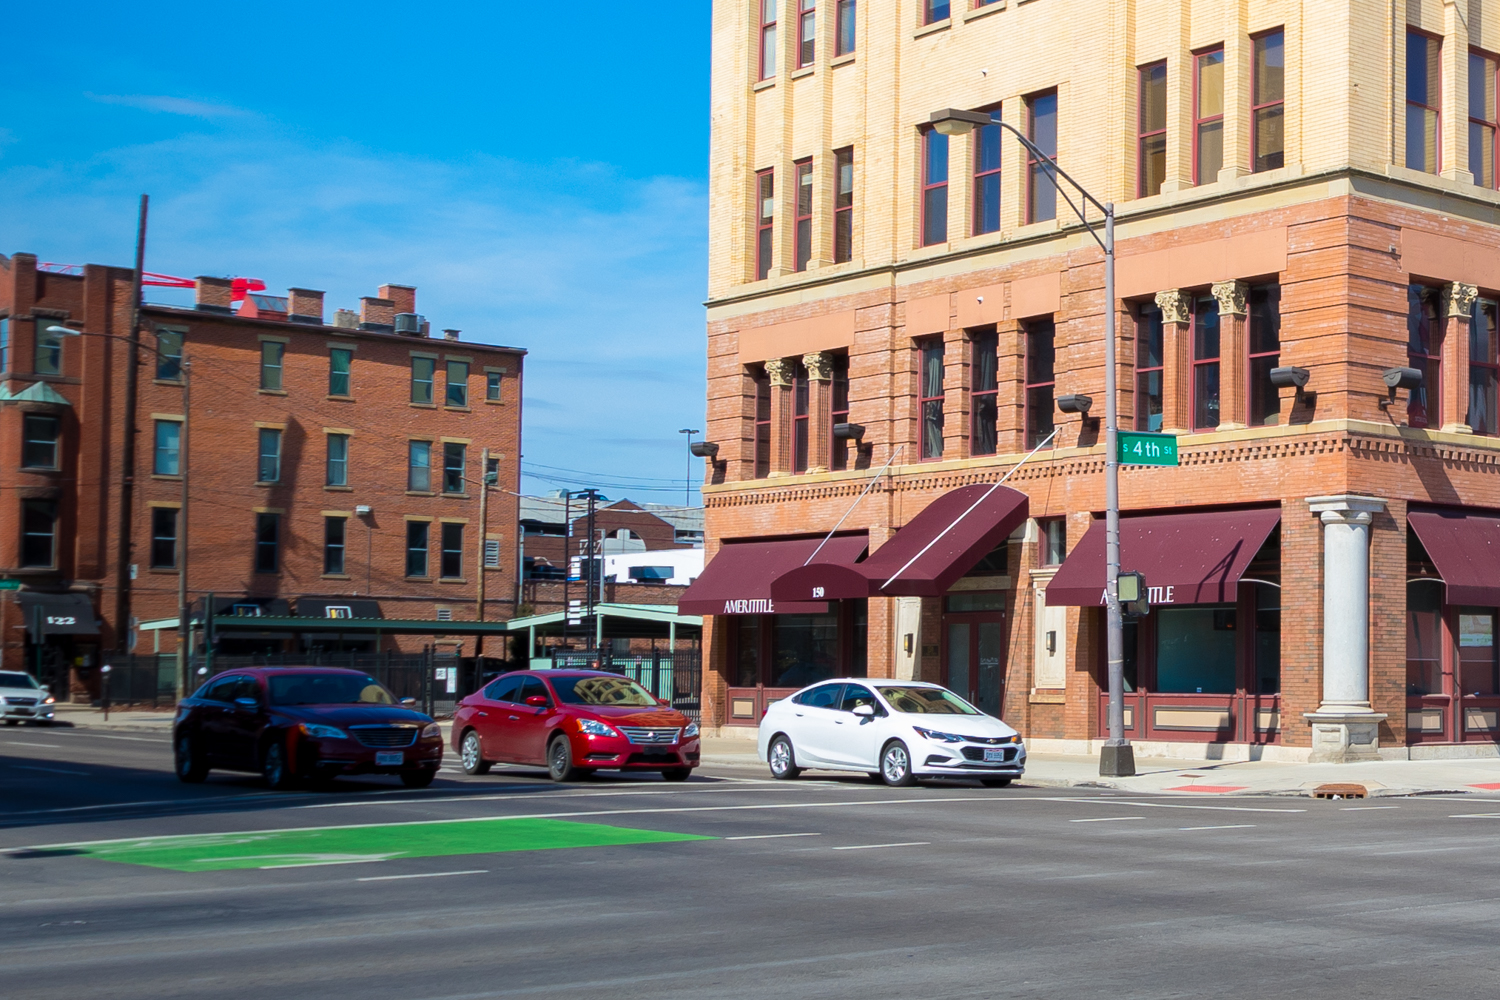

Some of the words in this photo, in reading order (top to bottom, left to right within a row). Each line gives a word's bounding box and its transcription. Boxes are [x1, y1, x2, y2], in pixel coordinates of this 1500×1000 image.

[1122, 443, 1129, 452] S
[1132, 440, 1160, 457] 4th
[1163, 446, 1172, 454] St
[812, 586, 825, 598] 150
[724, 599, 774, 614] AMERITITLE
[47, 616, 76, 625] 122
